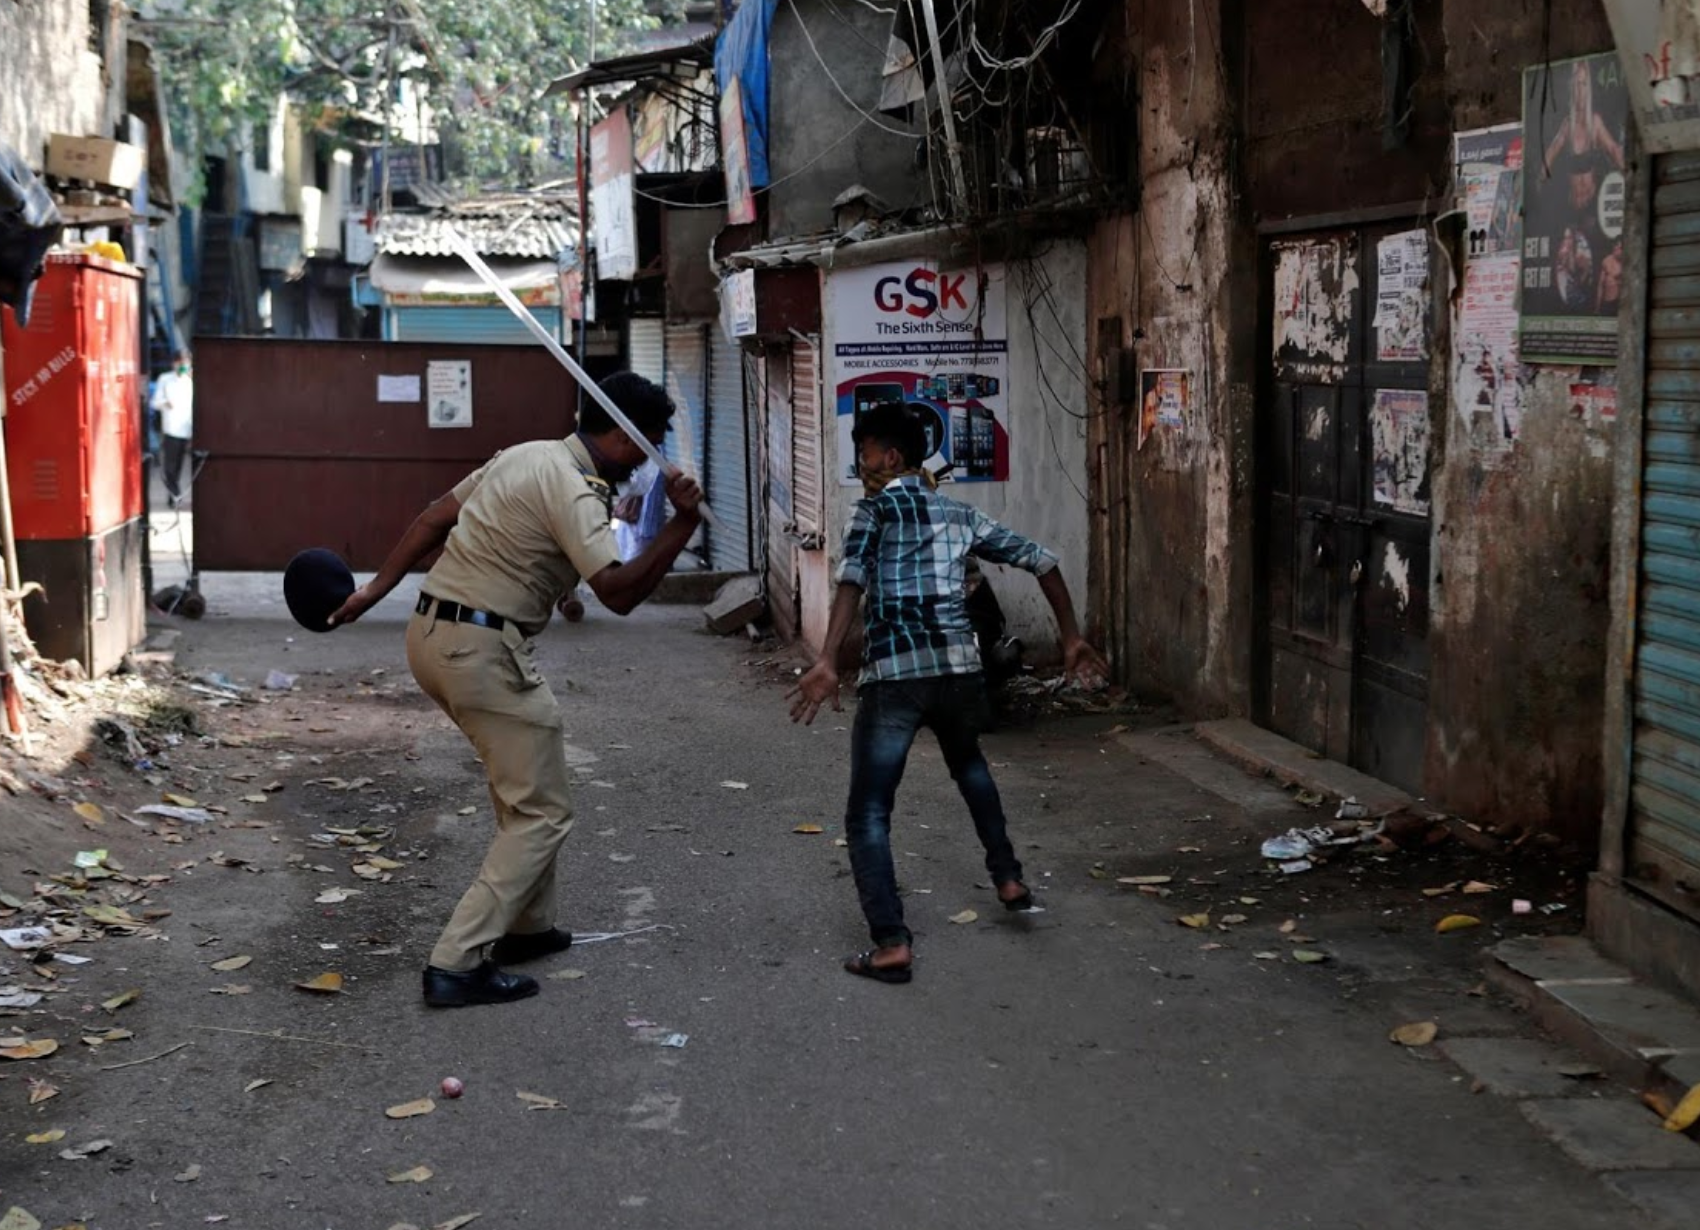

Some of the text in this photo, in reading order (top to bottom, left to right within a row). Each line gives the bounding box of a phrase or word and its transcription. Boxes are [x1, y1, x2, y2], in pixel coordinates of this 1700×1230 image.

[874, 267, 968, 319] GSK
[876, 320, 973, 335] The Sixth Sense
[872, 357, 919, 369] ACCESSORIES
